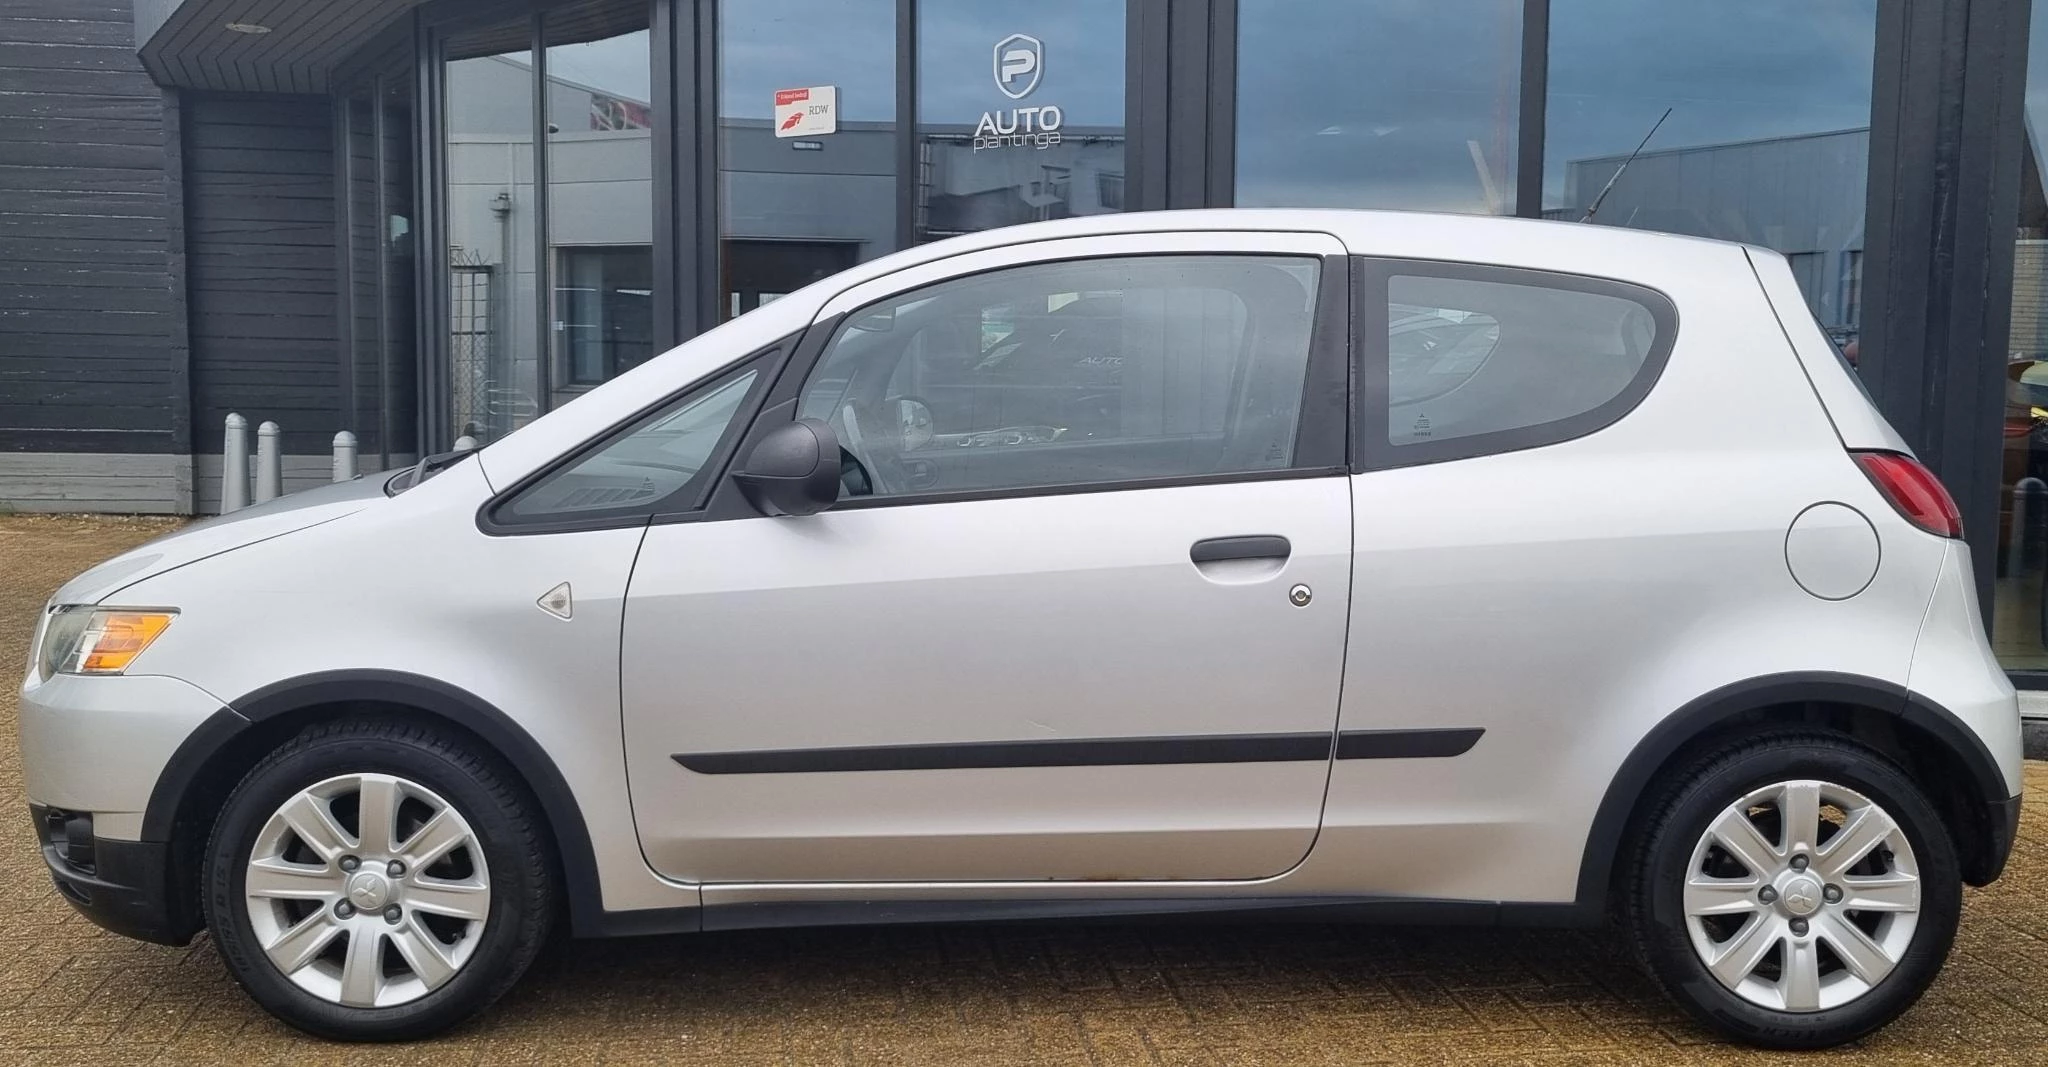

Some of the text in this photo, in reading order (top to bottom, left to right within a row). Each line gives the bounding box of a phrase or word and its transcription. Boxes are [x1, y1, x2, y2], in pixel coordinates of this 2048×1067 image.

[1002, 49, 1035, 83] P
[808, 104, 830, 116] RDW
[974, 105, 1061, 137] AUTO
[973, 131, 1061, 154] plantinga
